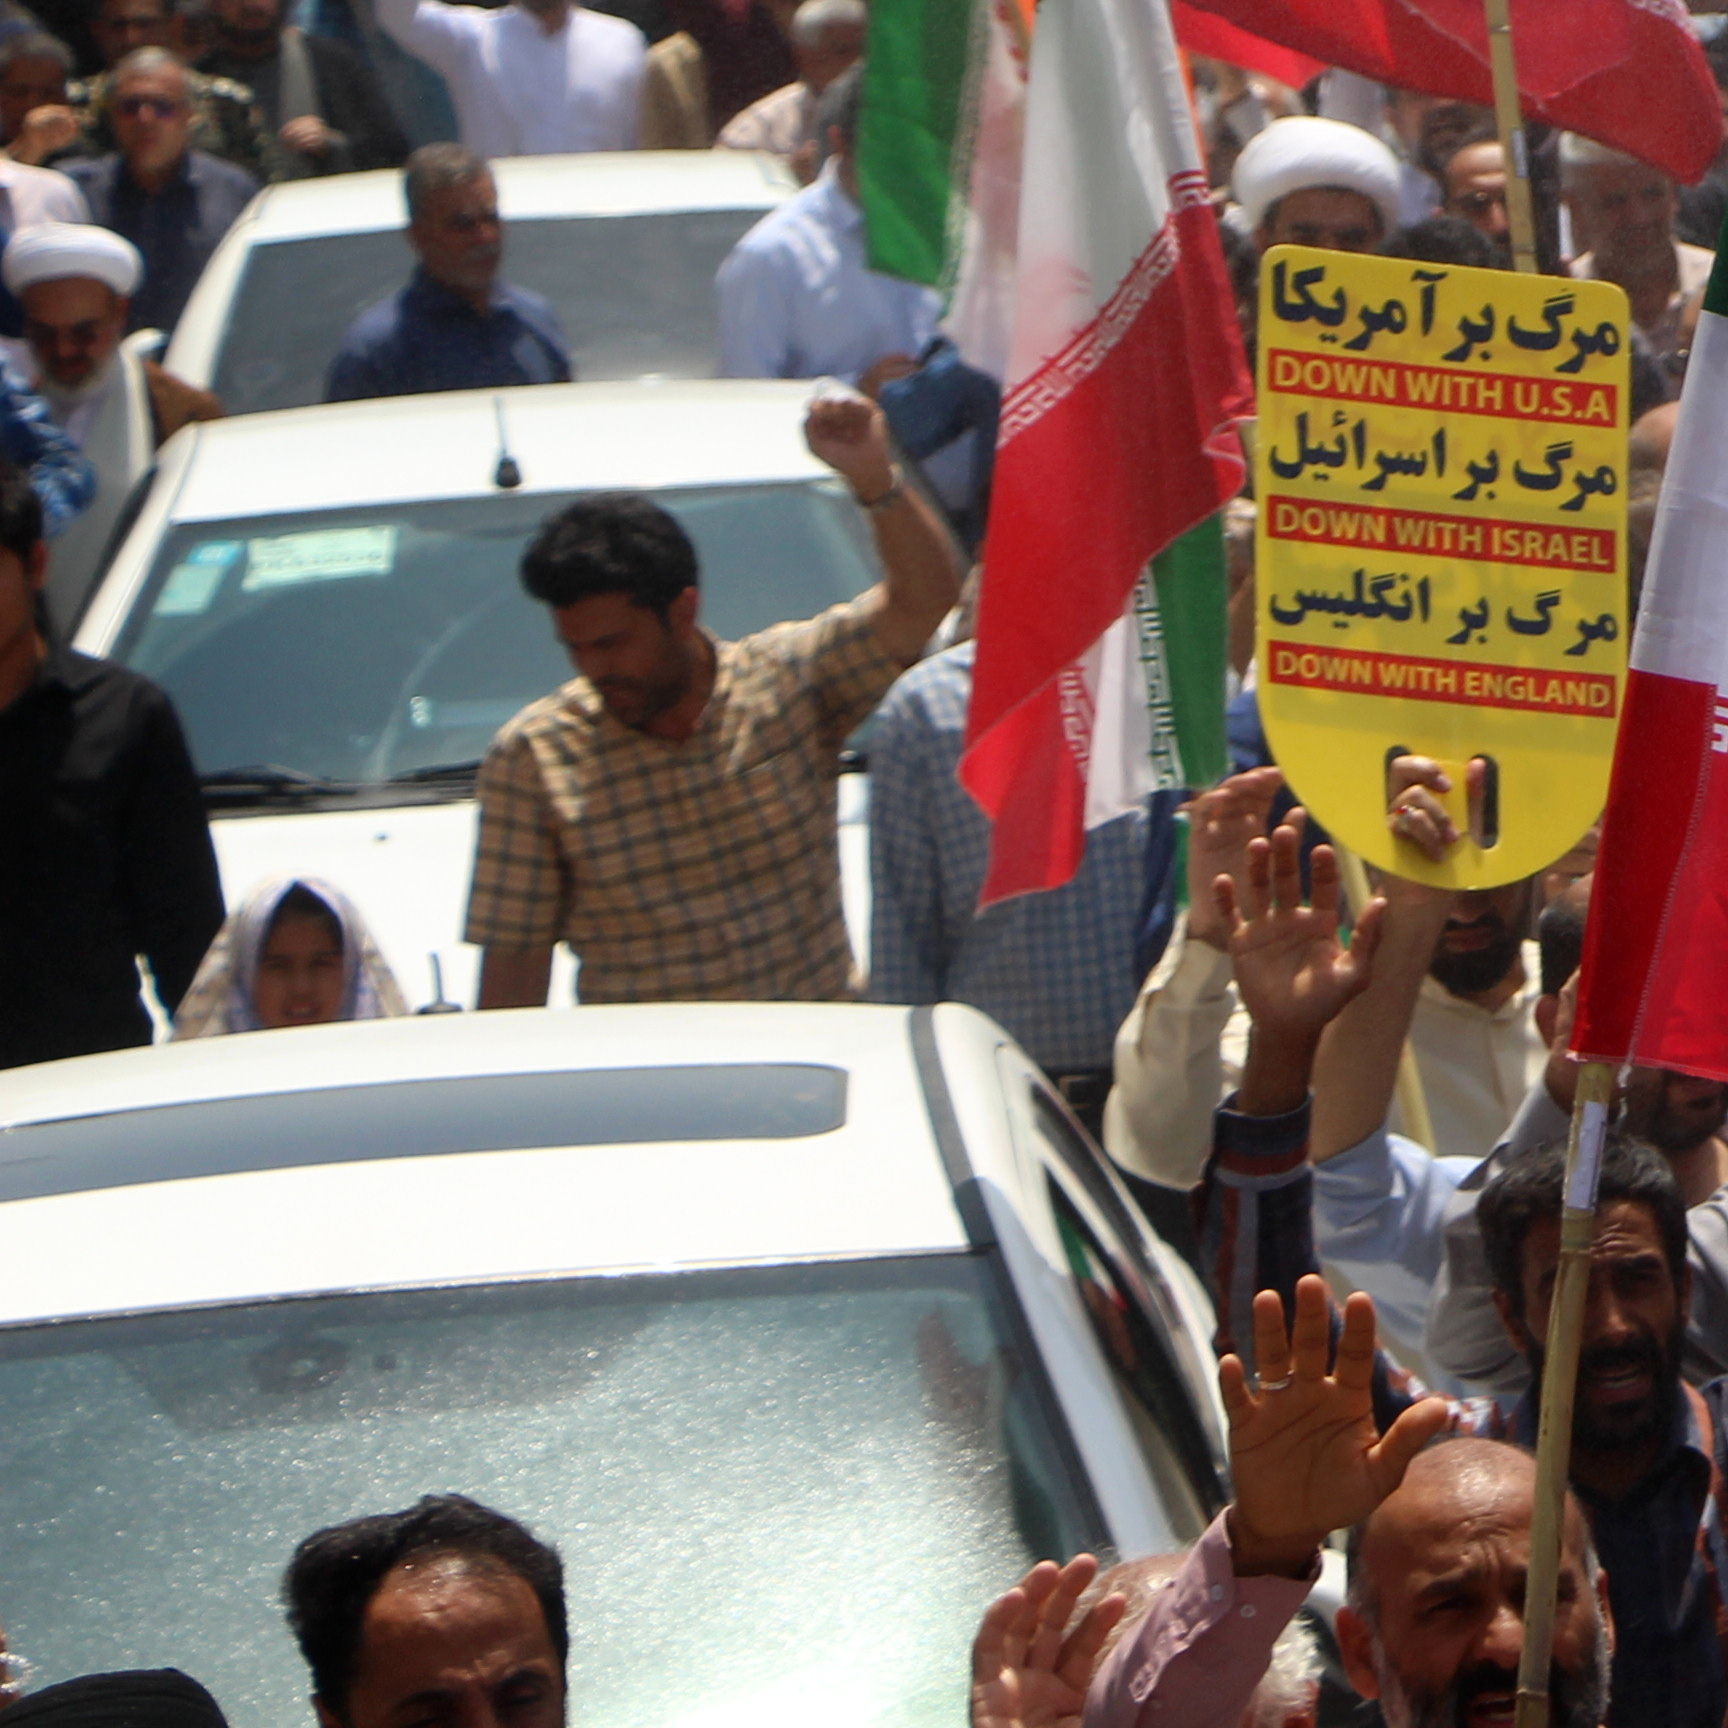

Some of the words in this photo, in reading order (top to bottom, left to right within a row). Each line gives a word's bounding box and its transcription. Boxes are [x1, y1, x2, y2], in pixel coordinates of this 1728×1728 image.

[1271, 260, 1448, 351] آمریکا
[1441, 303, 1495, 362] بر
[1507, 292, 1620, 373] مرگ
[1274, 355, 1396, 399] DOWN
[1404, 371, 1502, 411] WITH
[1513, 382, 1611, 420] U.S.A
[1269, 410, 1445, 490] اسرائیل
[1452, 449, 1499, 501] بر
[1513, 440, 1617, 511] مرگ
[1275, 503, 1386, 543] DOWN
[1394, 517, 1482, 554] WITH
[1492, 527, 1609, 565] ISRAEL
[1270, 568, 1429, 629] انگلیس
[1445, 597, 1489, 644] بر
[1506, 589, 1618, 656] مرگ
[1275, 650, 1371, 685] DOWN
[1378, 661, 1457, 694] WITH
[1464, 671, 1611, 708] ENGLAND
